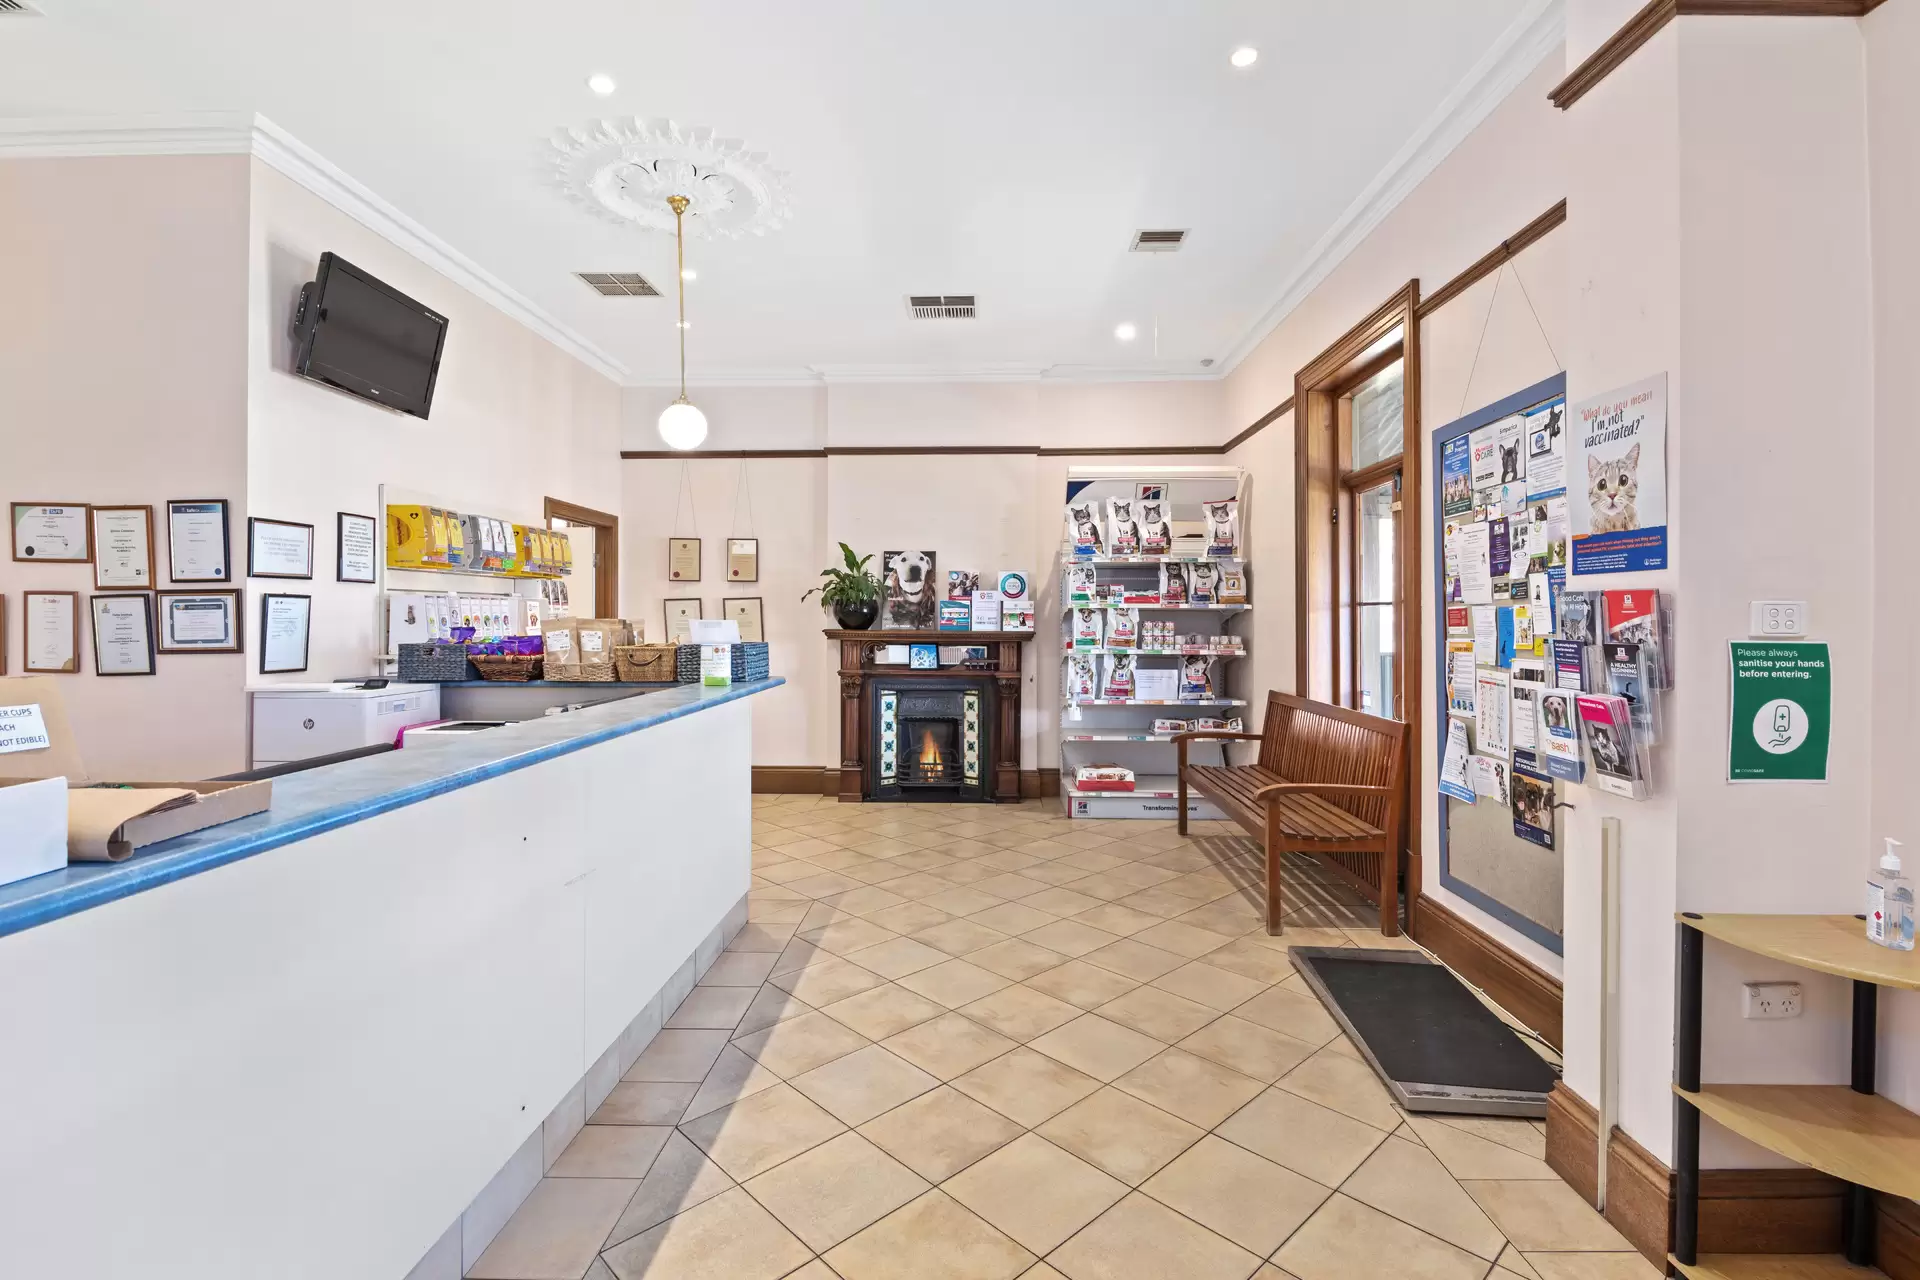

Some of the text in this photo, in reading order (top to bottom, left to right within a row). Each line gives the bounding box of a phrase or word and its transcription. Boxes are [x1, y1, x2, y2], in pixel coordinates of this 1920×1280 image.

[1602, 404, 1611, 416] do
[1614, 400, 1628, 414] you
[1630, 390, 1652, 406] mean
[1592, 409, 1624, 433] I'm not
[1584, 415, 1644, 448] vaccinated?"
[1481, 448, 1493, 460] CARE
[1738, 648, 1798, 658] Please always
[1772, 670, 1812, 679] entering.
[16, 735, 45, 744] EDIBLE)
[1552, 742, 1570, 752] sash
